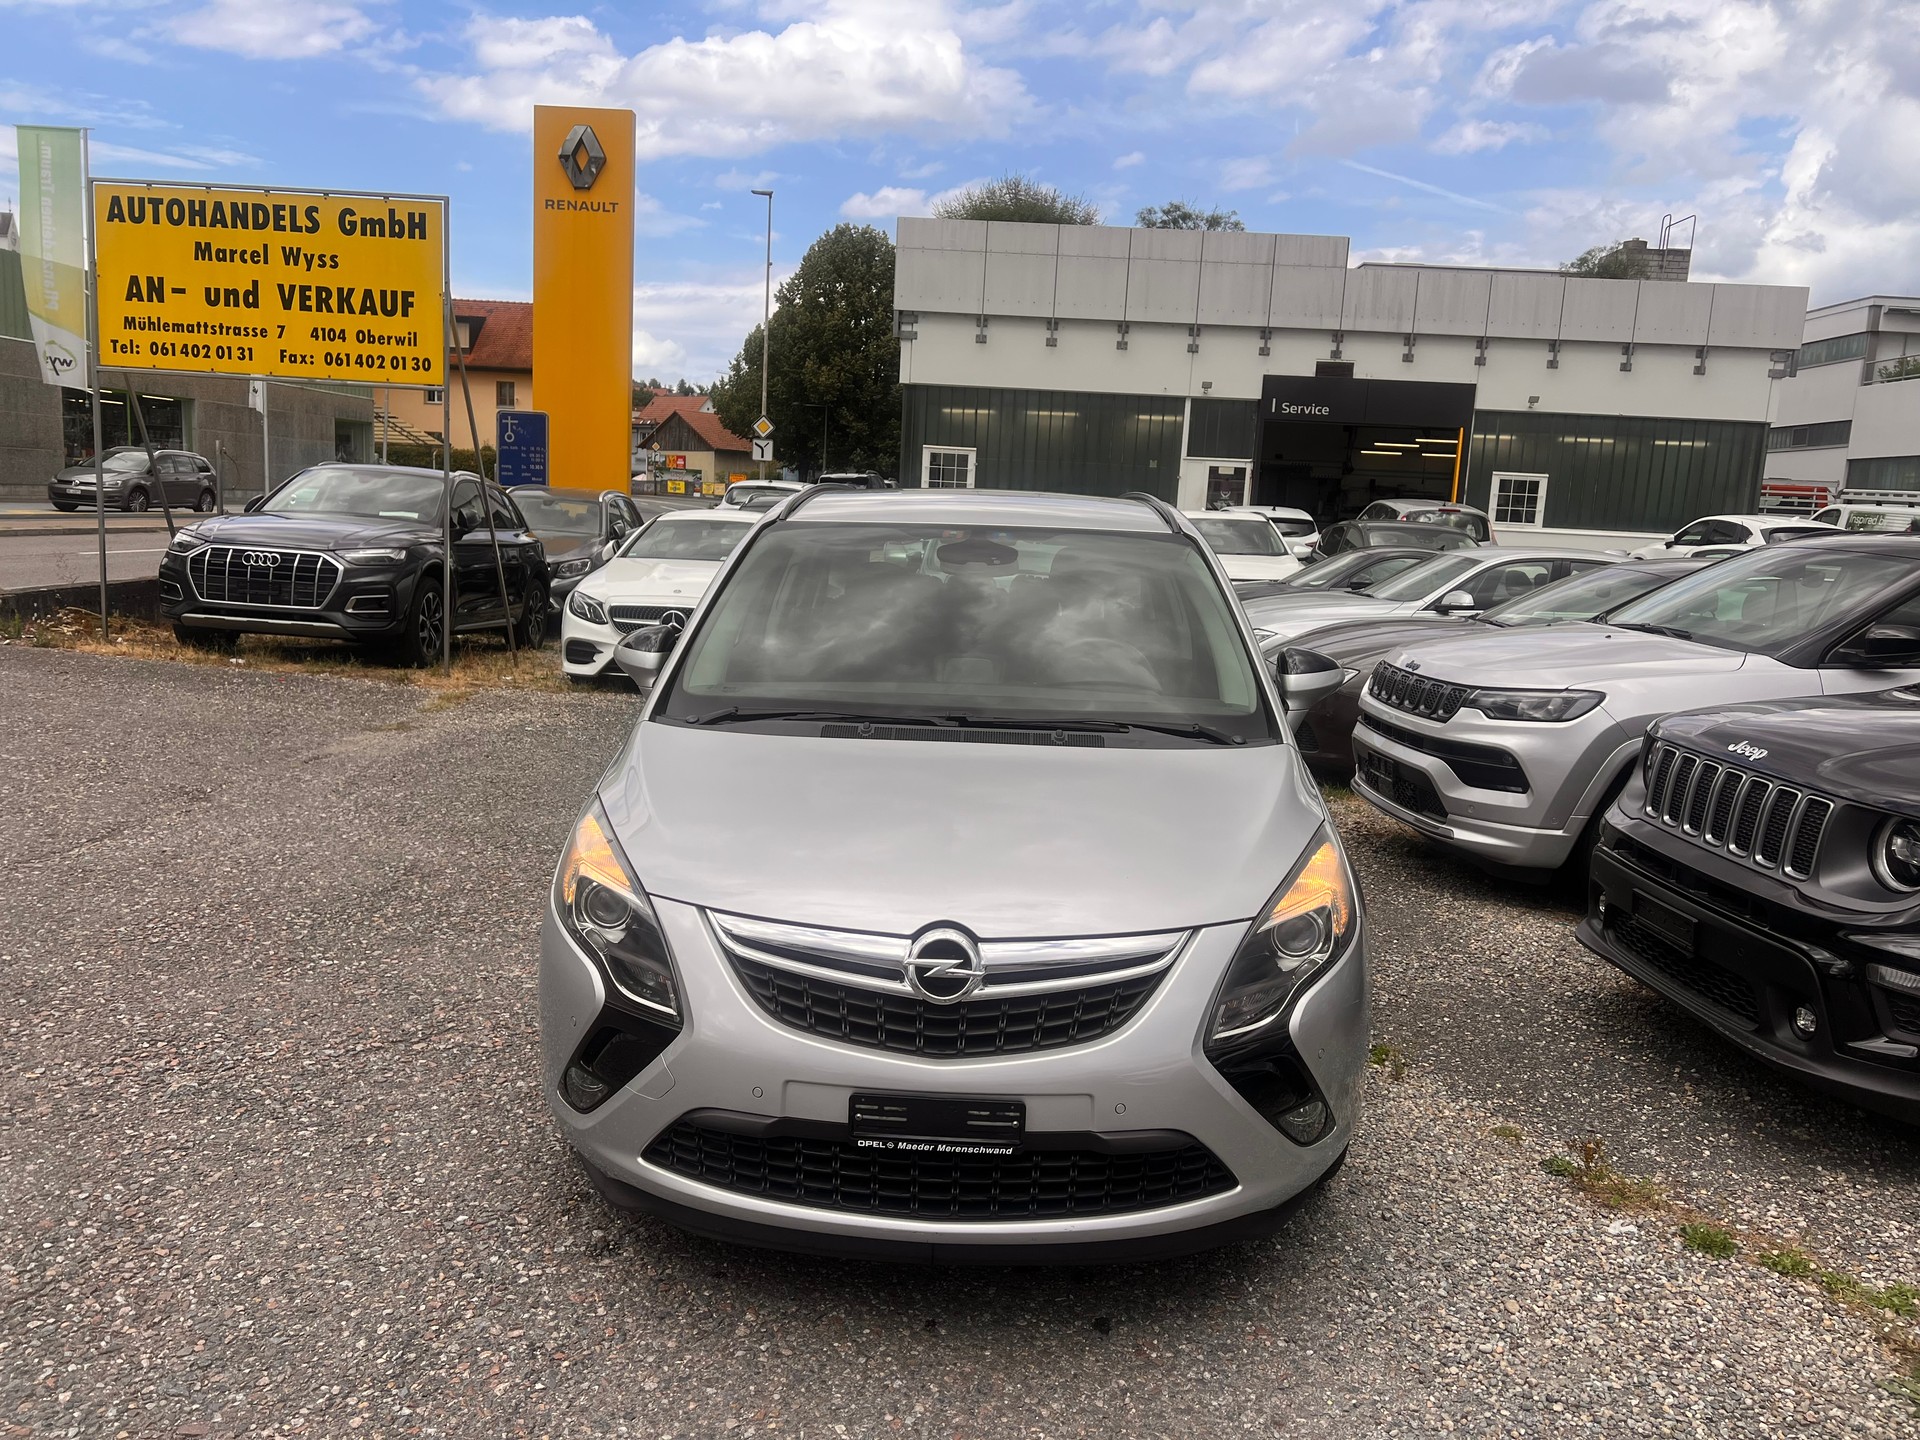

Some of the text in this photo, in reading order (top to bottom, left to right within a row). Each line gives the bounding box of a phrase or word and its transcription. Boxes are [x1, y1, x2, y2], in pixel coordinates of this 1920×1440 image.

[106, 195, 427, 240] AUTOHANDELS GmbH
[544, 199, 619, 213] RENAULT
[194, 241, 340, 272] Marcel Wyss
[204, 279, 260, 309] und
[276, 283, 415, 318] VERKAUF
[123, 315, 418, 347] Mühlemattstrasse 7 4104 Oberwil
[110, 338, 141, 355] Tel:
[279, 349, 315, 365] Fax:
[1281, 402, 1330, 415] Service
[1849, 513, 1880, 527] Inspired
[1727, 740, 1768, 761] Jeep
[857, 1140, 1013, 1155] OPEL Maeder Merenschwand
